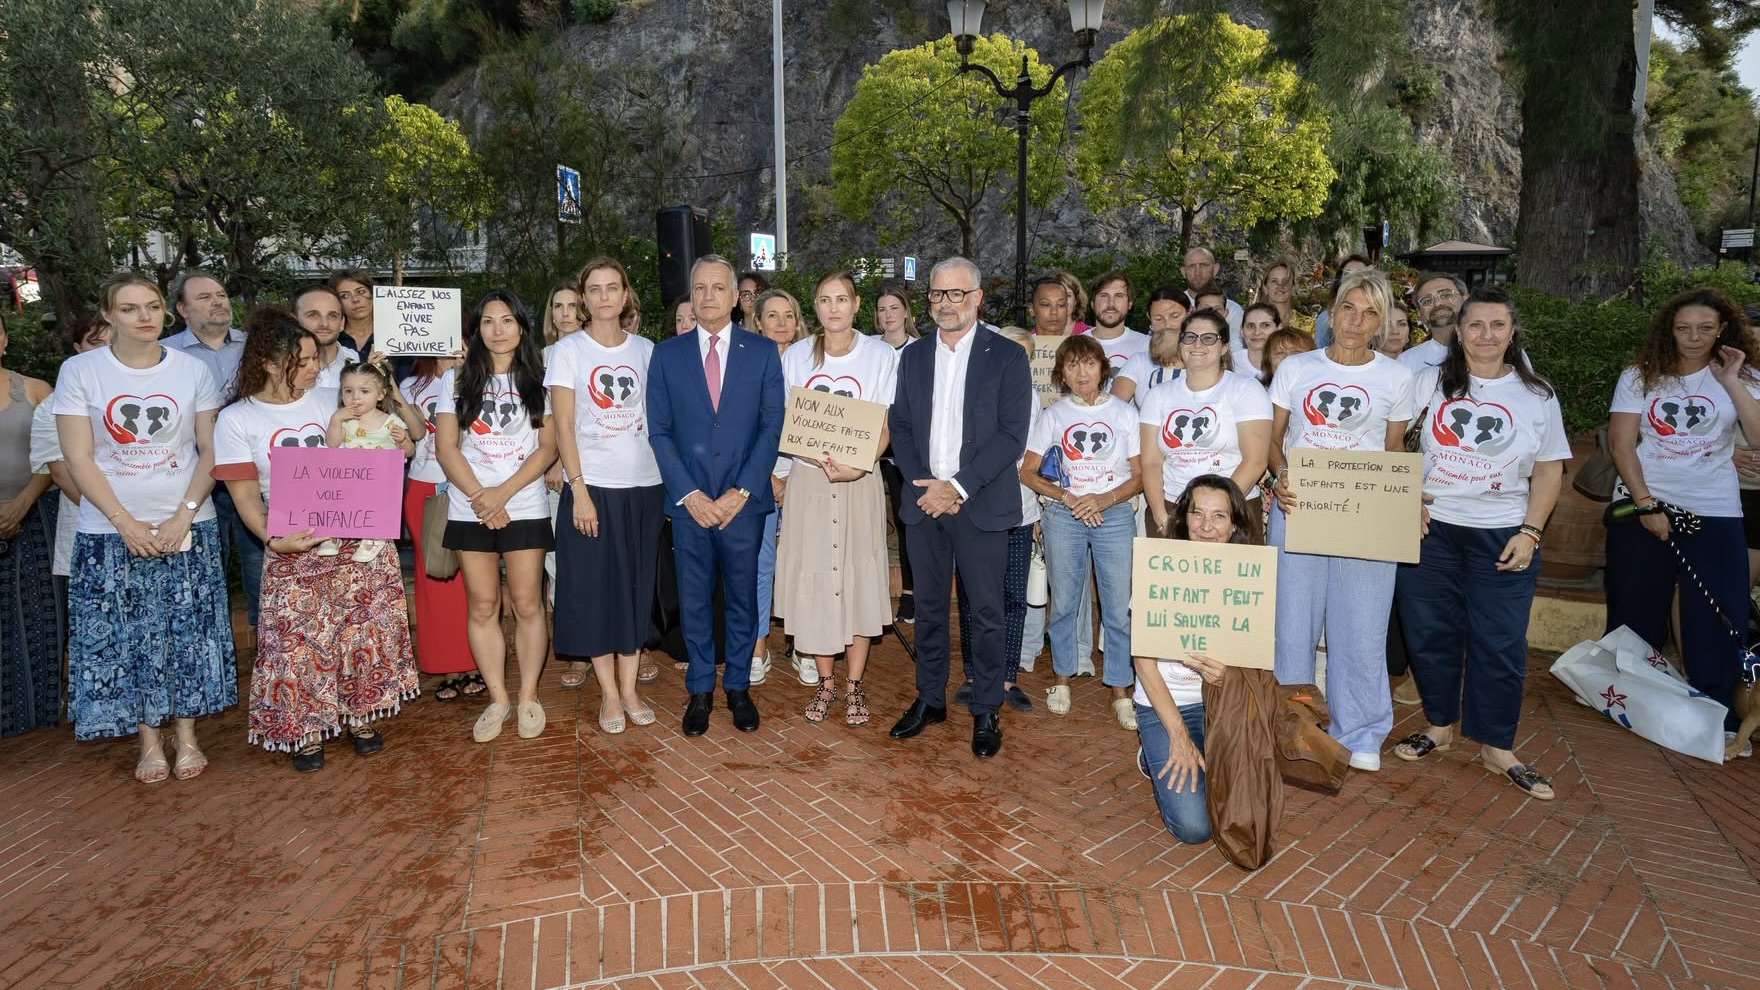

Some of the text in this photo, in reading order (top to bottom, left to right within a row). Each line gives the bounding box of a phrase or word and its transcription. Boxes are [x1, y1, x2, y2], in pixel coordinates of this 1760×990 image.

[432, 290, 451, 300] NOS
[396, 301, 435, 310] ENFANTS
[402, 311, 433, 323] VIVRE
[399, 323, 430, 336] PAS
[795, 397, 845, 418] NON AUX
[792, 414, 870, 440] VIOLENCES FAITES
[1312, 431, 1351, 441] MONACO
[787, 434, 857, 455] AUX ENFANTS
[110, 452, 122, 462] Tous
[121, 461, 151, 469] ensemble
[153, 460, 166, 470] pour
[1301, 457, 1410, 473] LA PROTECTION DES
[1440, 452, 1492, 470] MONACO
[293, 465, 374, 480] LA VIOLENCE
[1437, 467, 1469, 481] ensemble
[1470, 475, 1487, 484] pour
[1300, 478, 1410, 494] ENFANTS EST UNE
[316, 490, 344, 500] VOLE
[1300, 498, 1350, 512] PRIORITÉ
[1148, 555, 1261, 577] CROIRE UN
[1149, 584, 1264, 606] ENFANT PEUT
[1174, 612, 1220, 628] SAUVER
[1232, 617, 1250, 632] LA
[1180, 634, 1207, 651] VIE
